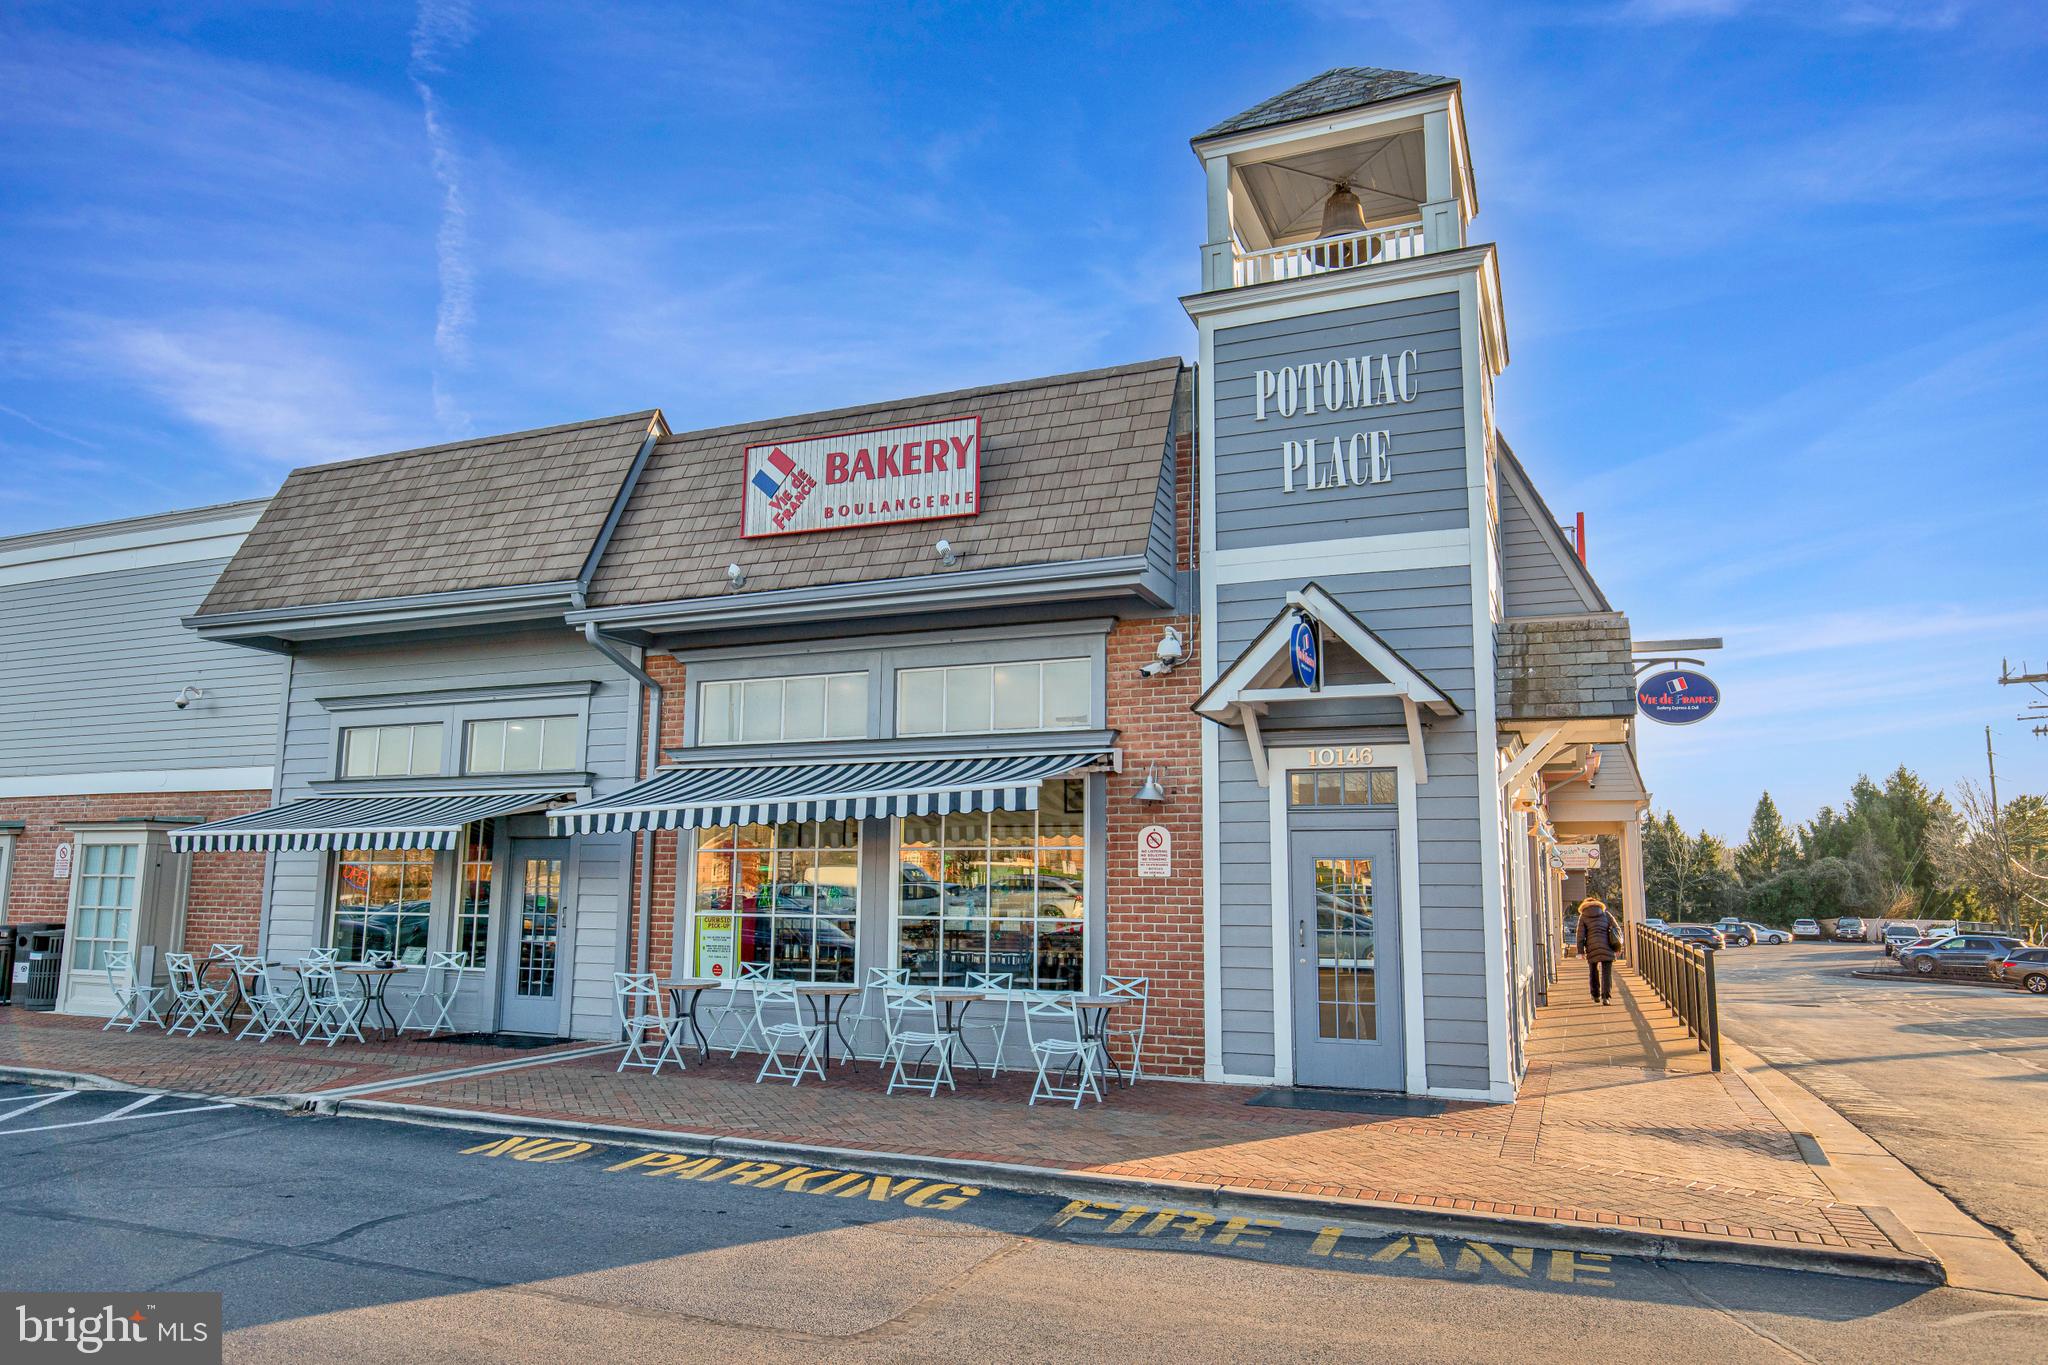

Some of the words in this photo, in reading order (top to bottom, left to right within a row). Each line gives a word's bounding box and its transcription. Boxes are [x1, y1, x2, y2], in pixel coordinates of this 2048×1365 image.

[1254, 349, 1418, 421] POTOMAC
[825, 434, 975, 486] BAKERY
[1281, 430, 1392, 493] PLACE
[769, 488, 793, 511] VIE
[772, 475, 817, 530] FRANCE
[824, 491, 974, 519] BOULANGERIE
[1640, 693, 1657, 704] VIE
[1307, 747, 1374, 766] 10146
[457, 1136, 593, 1163] NO
[602, 1152, 981, 1211] PARKING
[1049, 1199, 1281, 1249] FIRE
[1306, 1226, 1616, 1288] LANE
